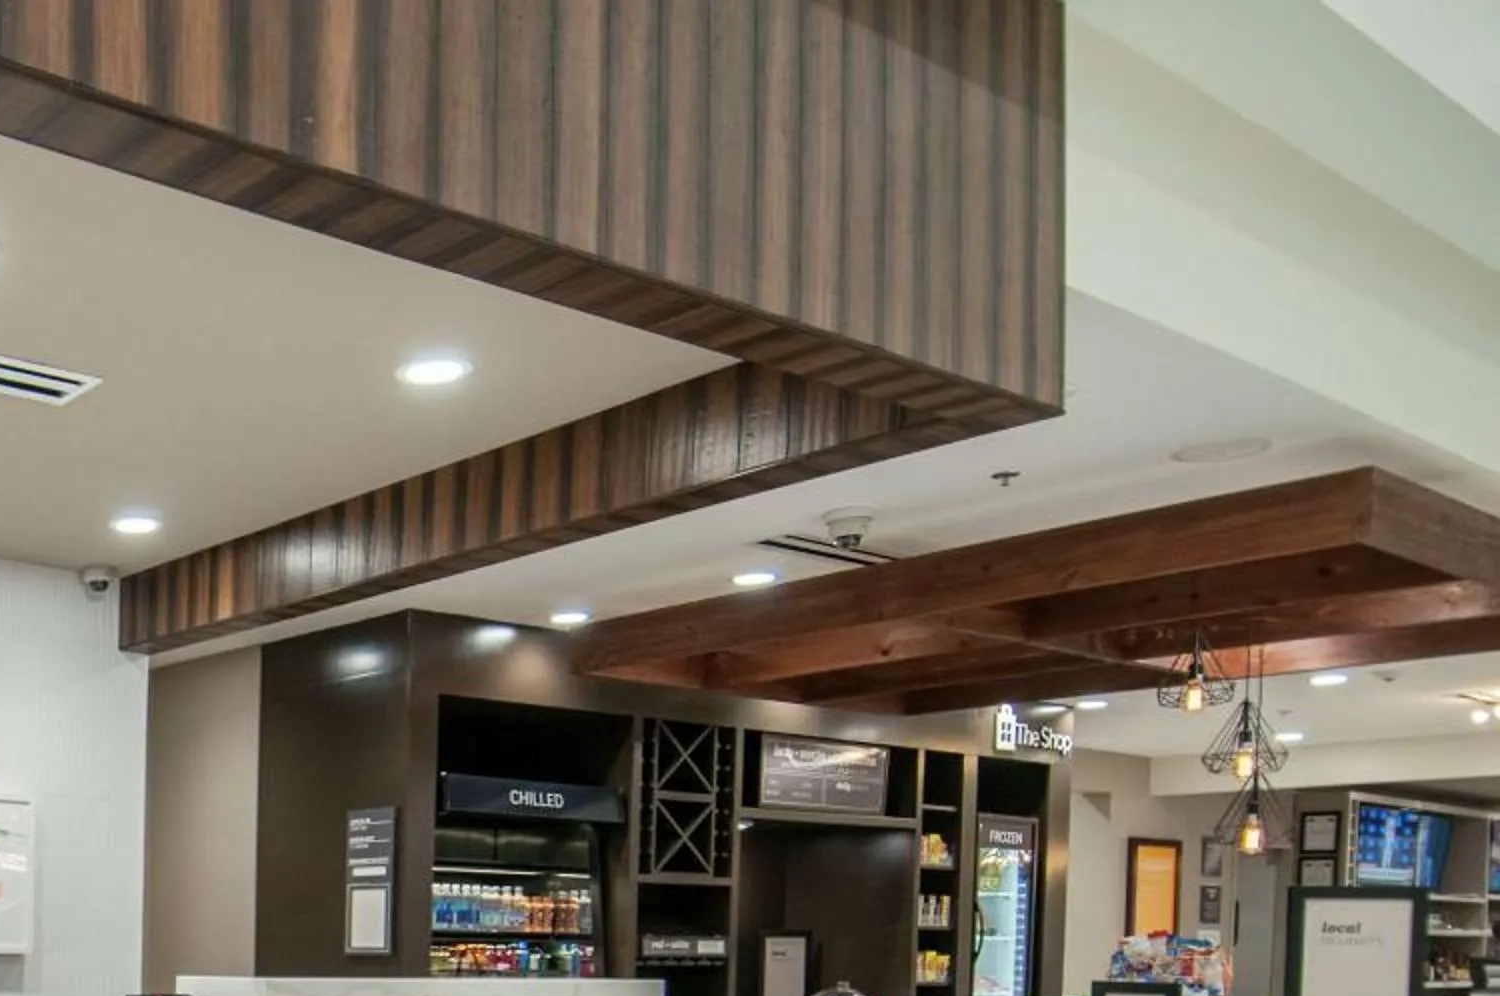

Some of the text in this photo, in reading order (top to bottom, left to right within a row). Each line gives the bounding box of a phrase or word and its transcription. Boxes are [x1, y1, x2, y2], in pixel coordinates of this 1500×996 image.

[1016, 723, 1073, 756] The Shop
[509, 789, 565, 809] CHILLED
[989, 830, 1023, 845] FROZEN
[1322, 920, 1362, 934] local
